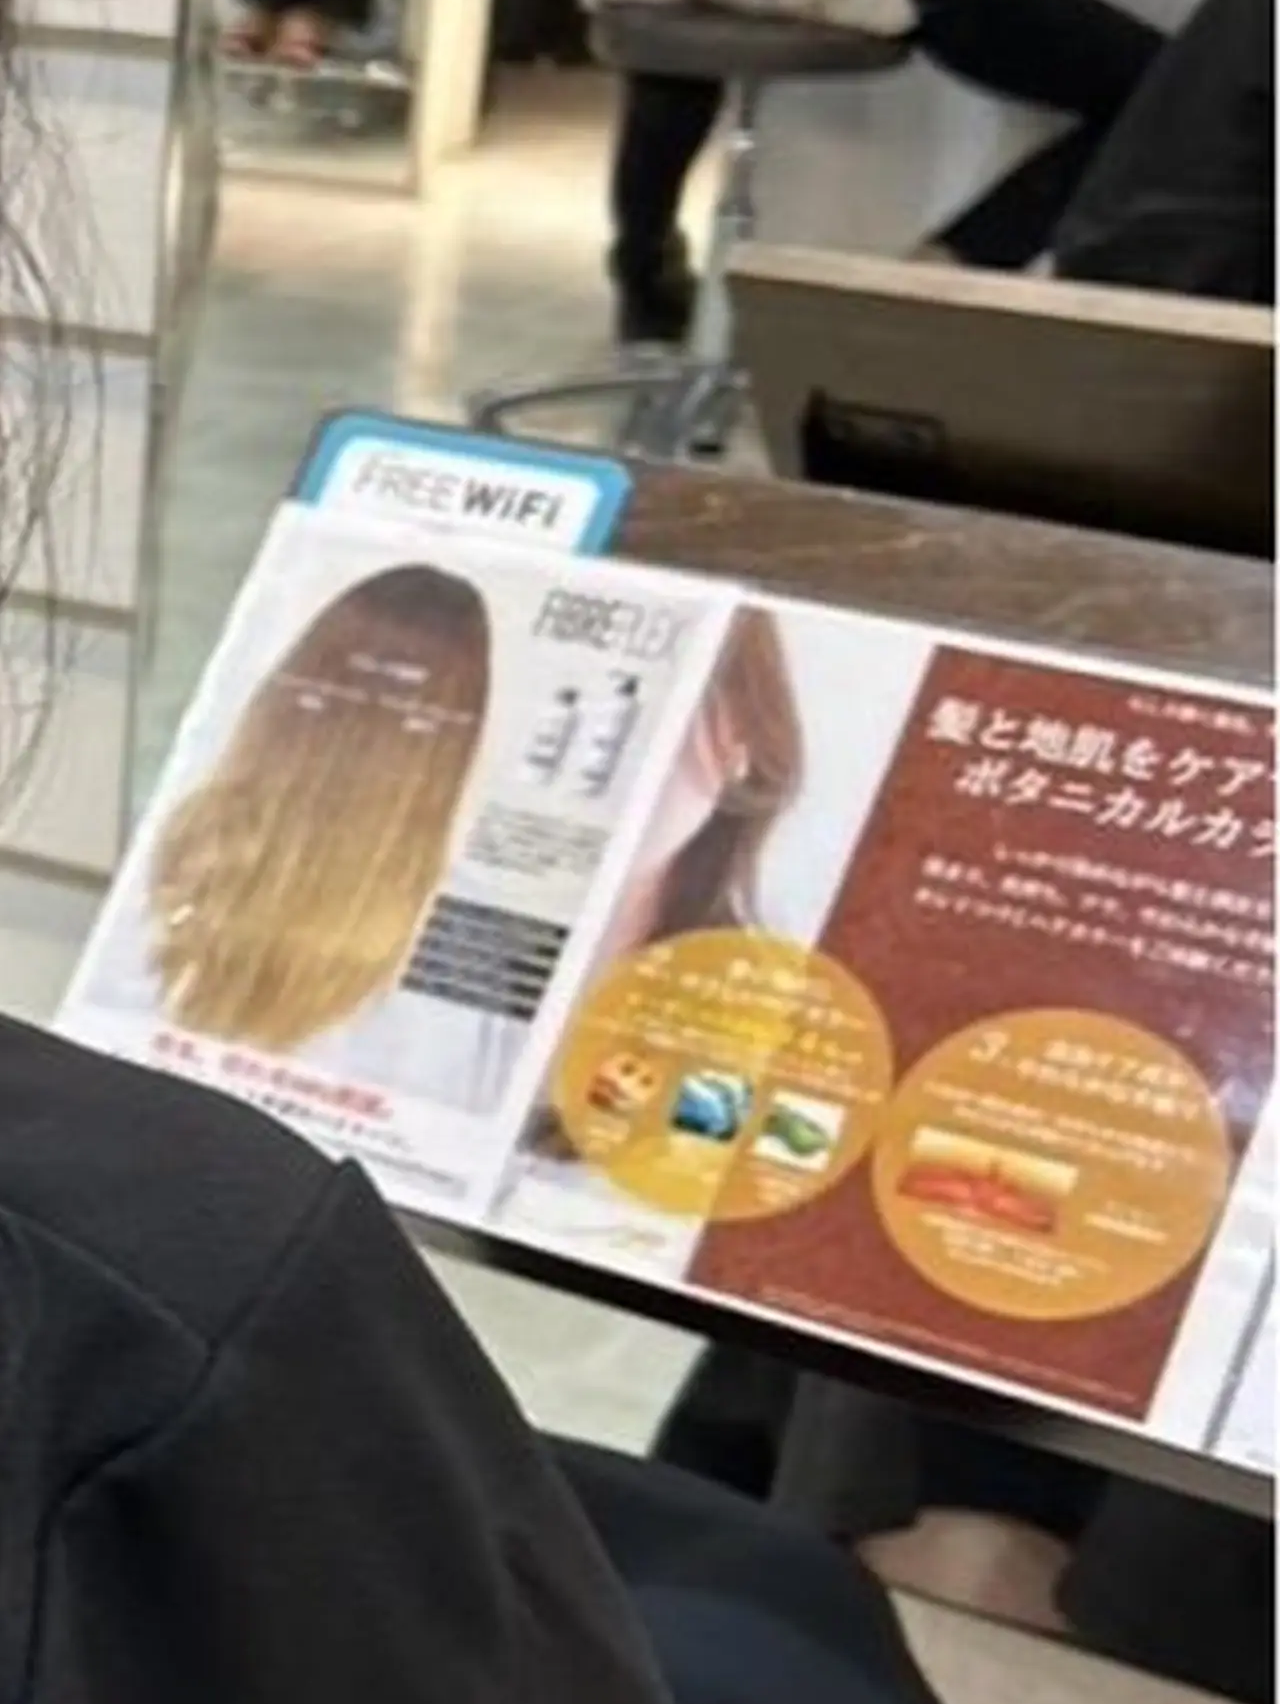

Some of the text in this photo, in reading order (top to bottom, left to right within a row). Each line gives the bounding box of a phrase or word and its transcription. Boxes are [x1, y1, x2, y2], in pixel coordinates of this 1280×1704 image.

[353, 452, 462, 512] FREE
[925, 697, 1274, 796] 髪と地肌をケア
